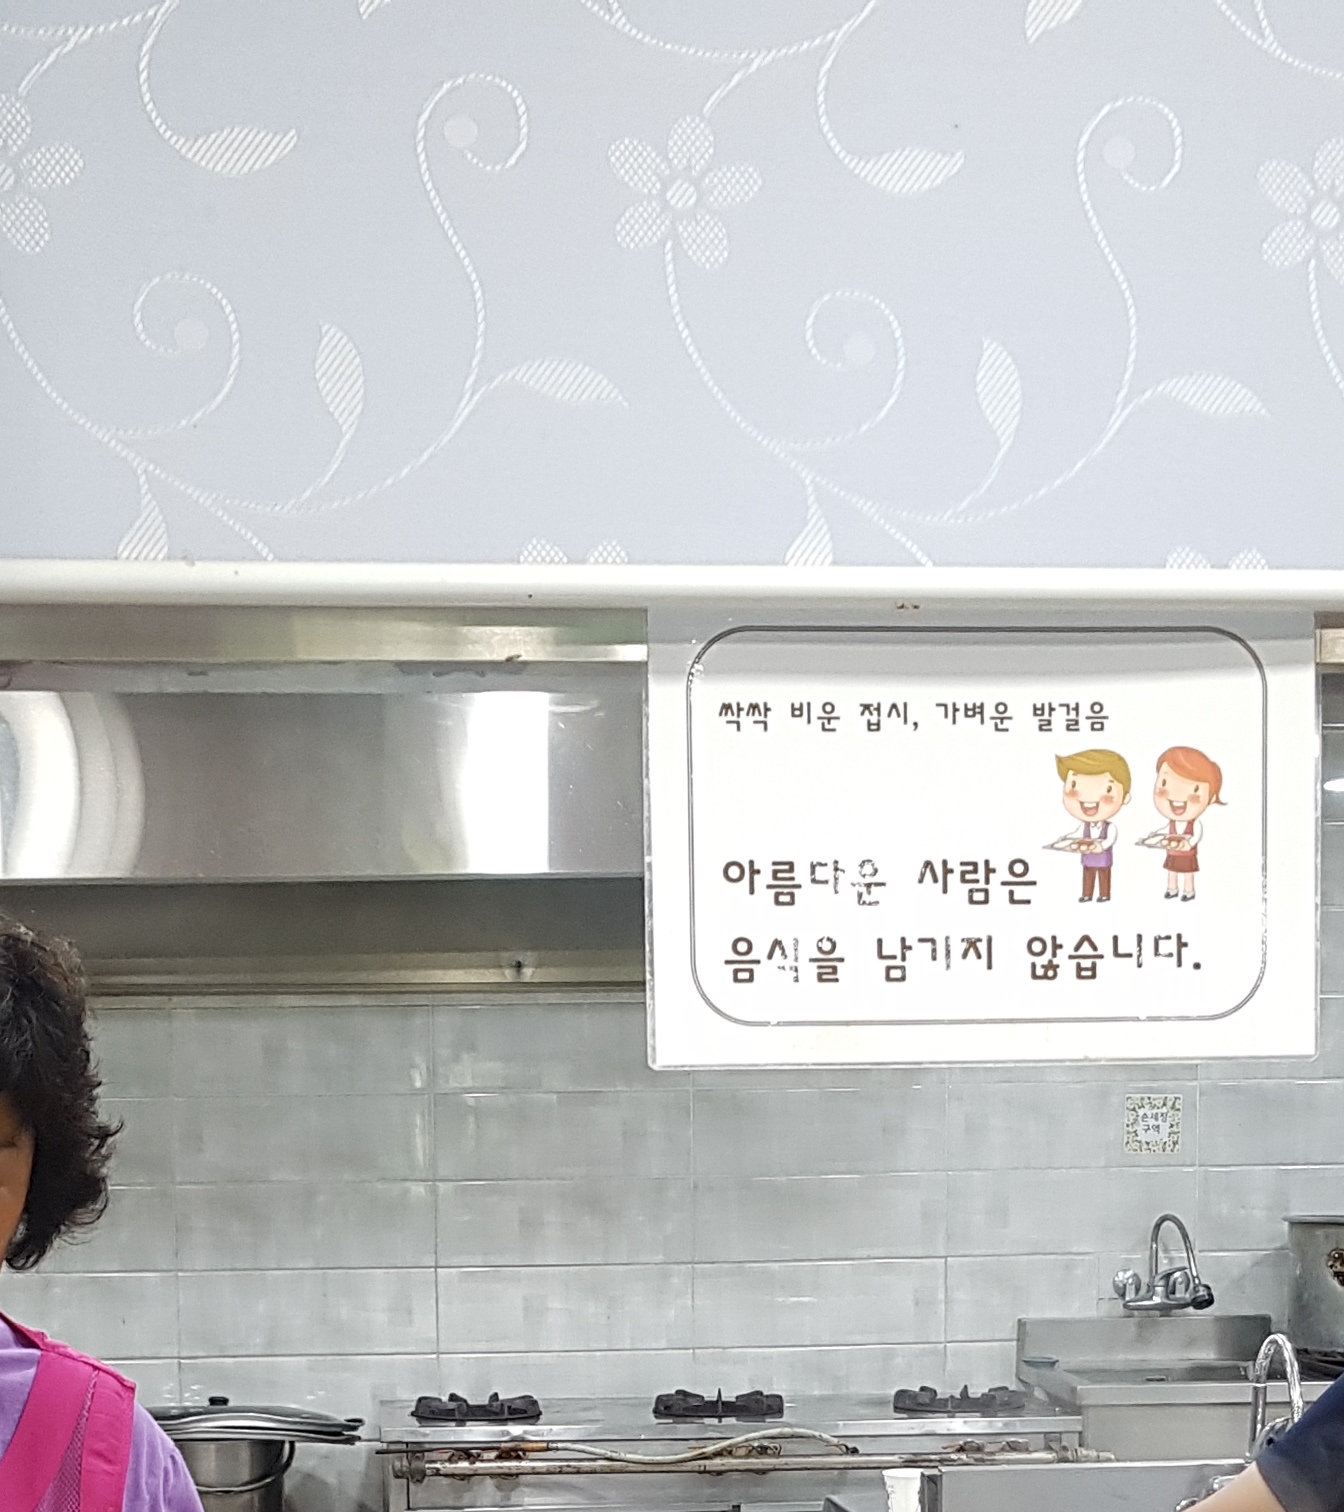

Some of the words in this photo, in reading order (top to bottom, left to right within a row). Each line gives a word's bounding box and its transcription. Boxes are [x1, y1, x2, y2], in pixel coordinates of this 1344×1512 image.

[718, 701, 772, 733] 싹싹
[790, 701, 841, 733] 비운
[859, 701, 919, 733] 접시,
[935, 701, 1014, 733] 가벼운
[1032, 701, 1110, 733] 발걸음
[722, 858, 887, 907] 아름다운
[917, 857, 1038, 906] 사람은
[723, 936, 846, 984] 음식을
[876, 934, 993, 983] 남기지
[1026, 932, 1202, 981] 않습니다.
[1141, 1124, 1161, 1135] 구역
